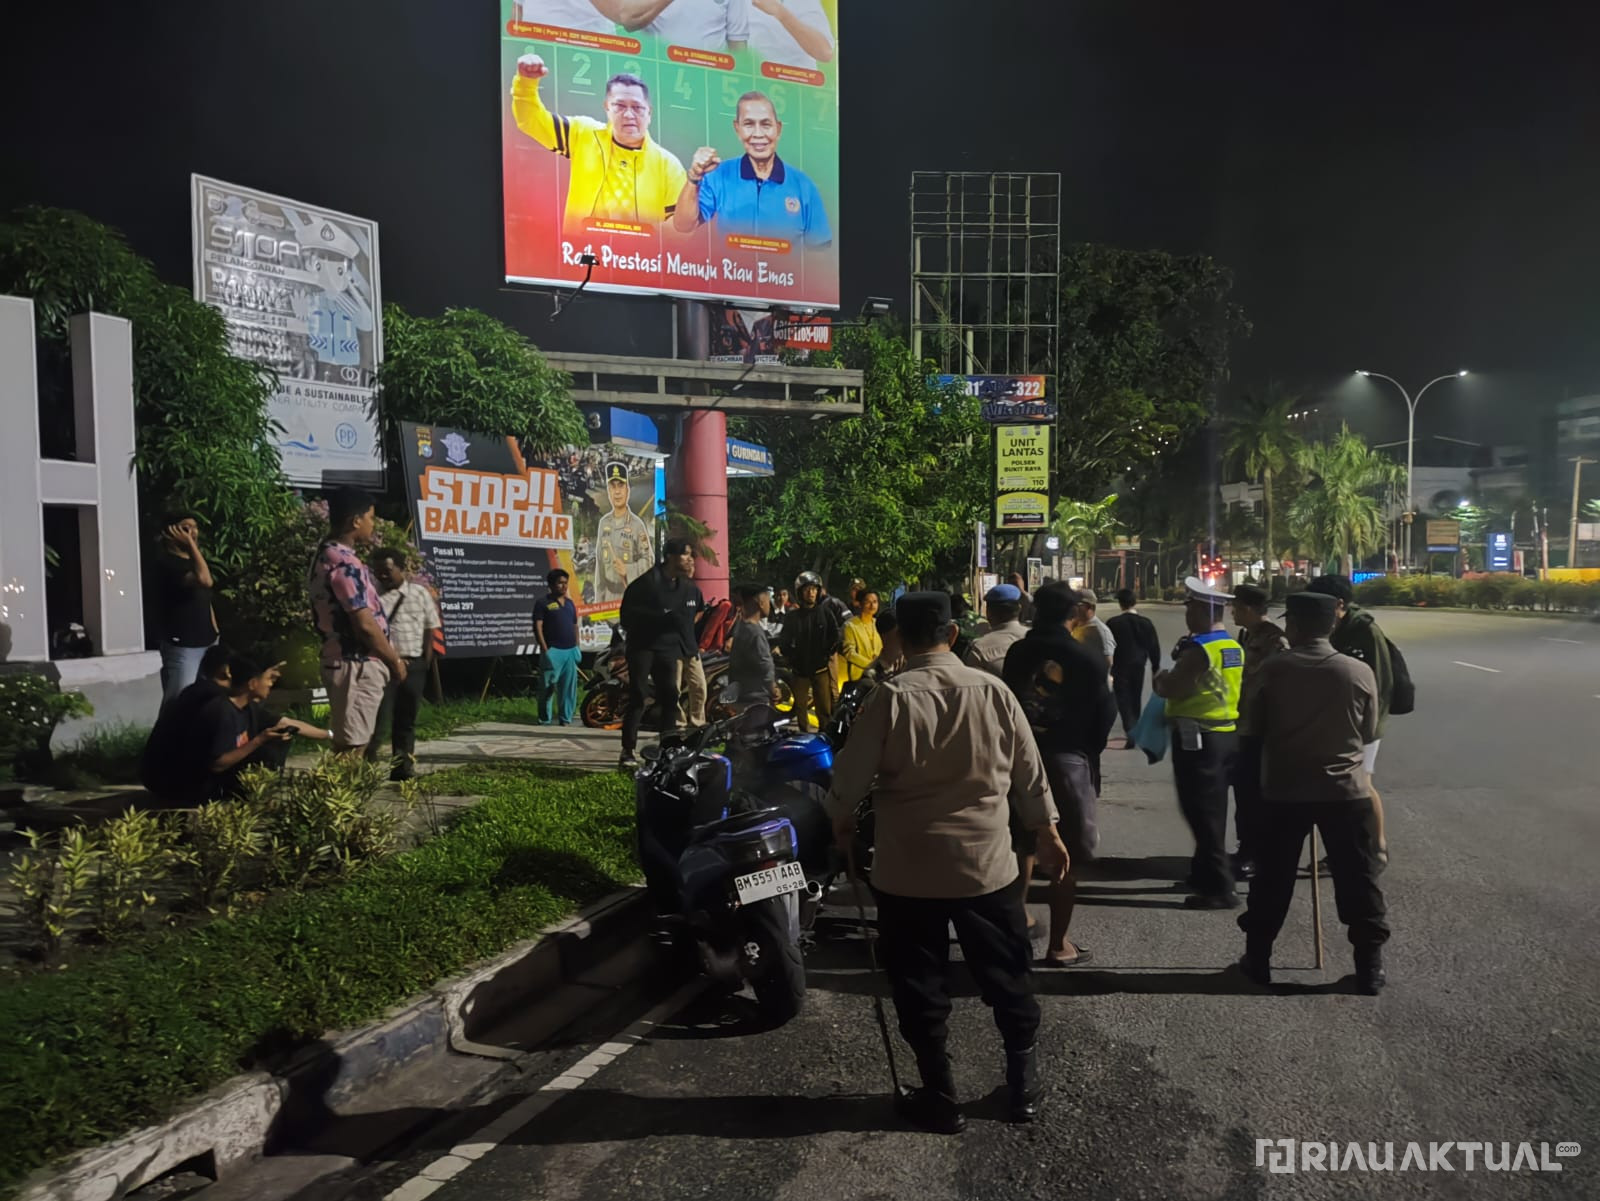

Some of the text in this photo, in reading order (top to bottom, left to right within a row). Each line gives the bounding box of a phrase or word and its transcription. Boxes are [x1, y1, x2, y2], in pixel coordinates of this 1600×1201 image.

[572, 51, 593, 85] 2
[673, 67, 693, 100] 4
[721, 75, 740, 108] 5
[601, 244, 663, 274] Prestasi
[666, 252, 718, 282] Menuju
[721, 258, 753, 283] Riau
[757, 261, 794, 287] Emas
[1002, 447, 1044, 457] LANTAS
[1010, 438, 1037, 447] UNIT
[427, 470, 557, 513] STOP!!
[425, 507, 570, 541] BALAP LIAR
[432, 546, 465, 557] Pasal 115
[440, 602, 474, 611] Pasal 297
[735, 863, 801, 892] BM 5551 AAB
